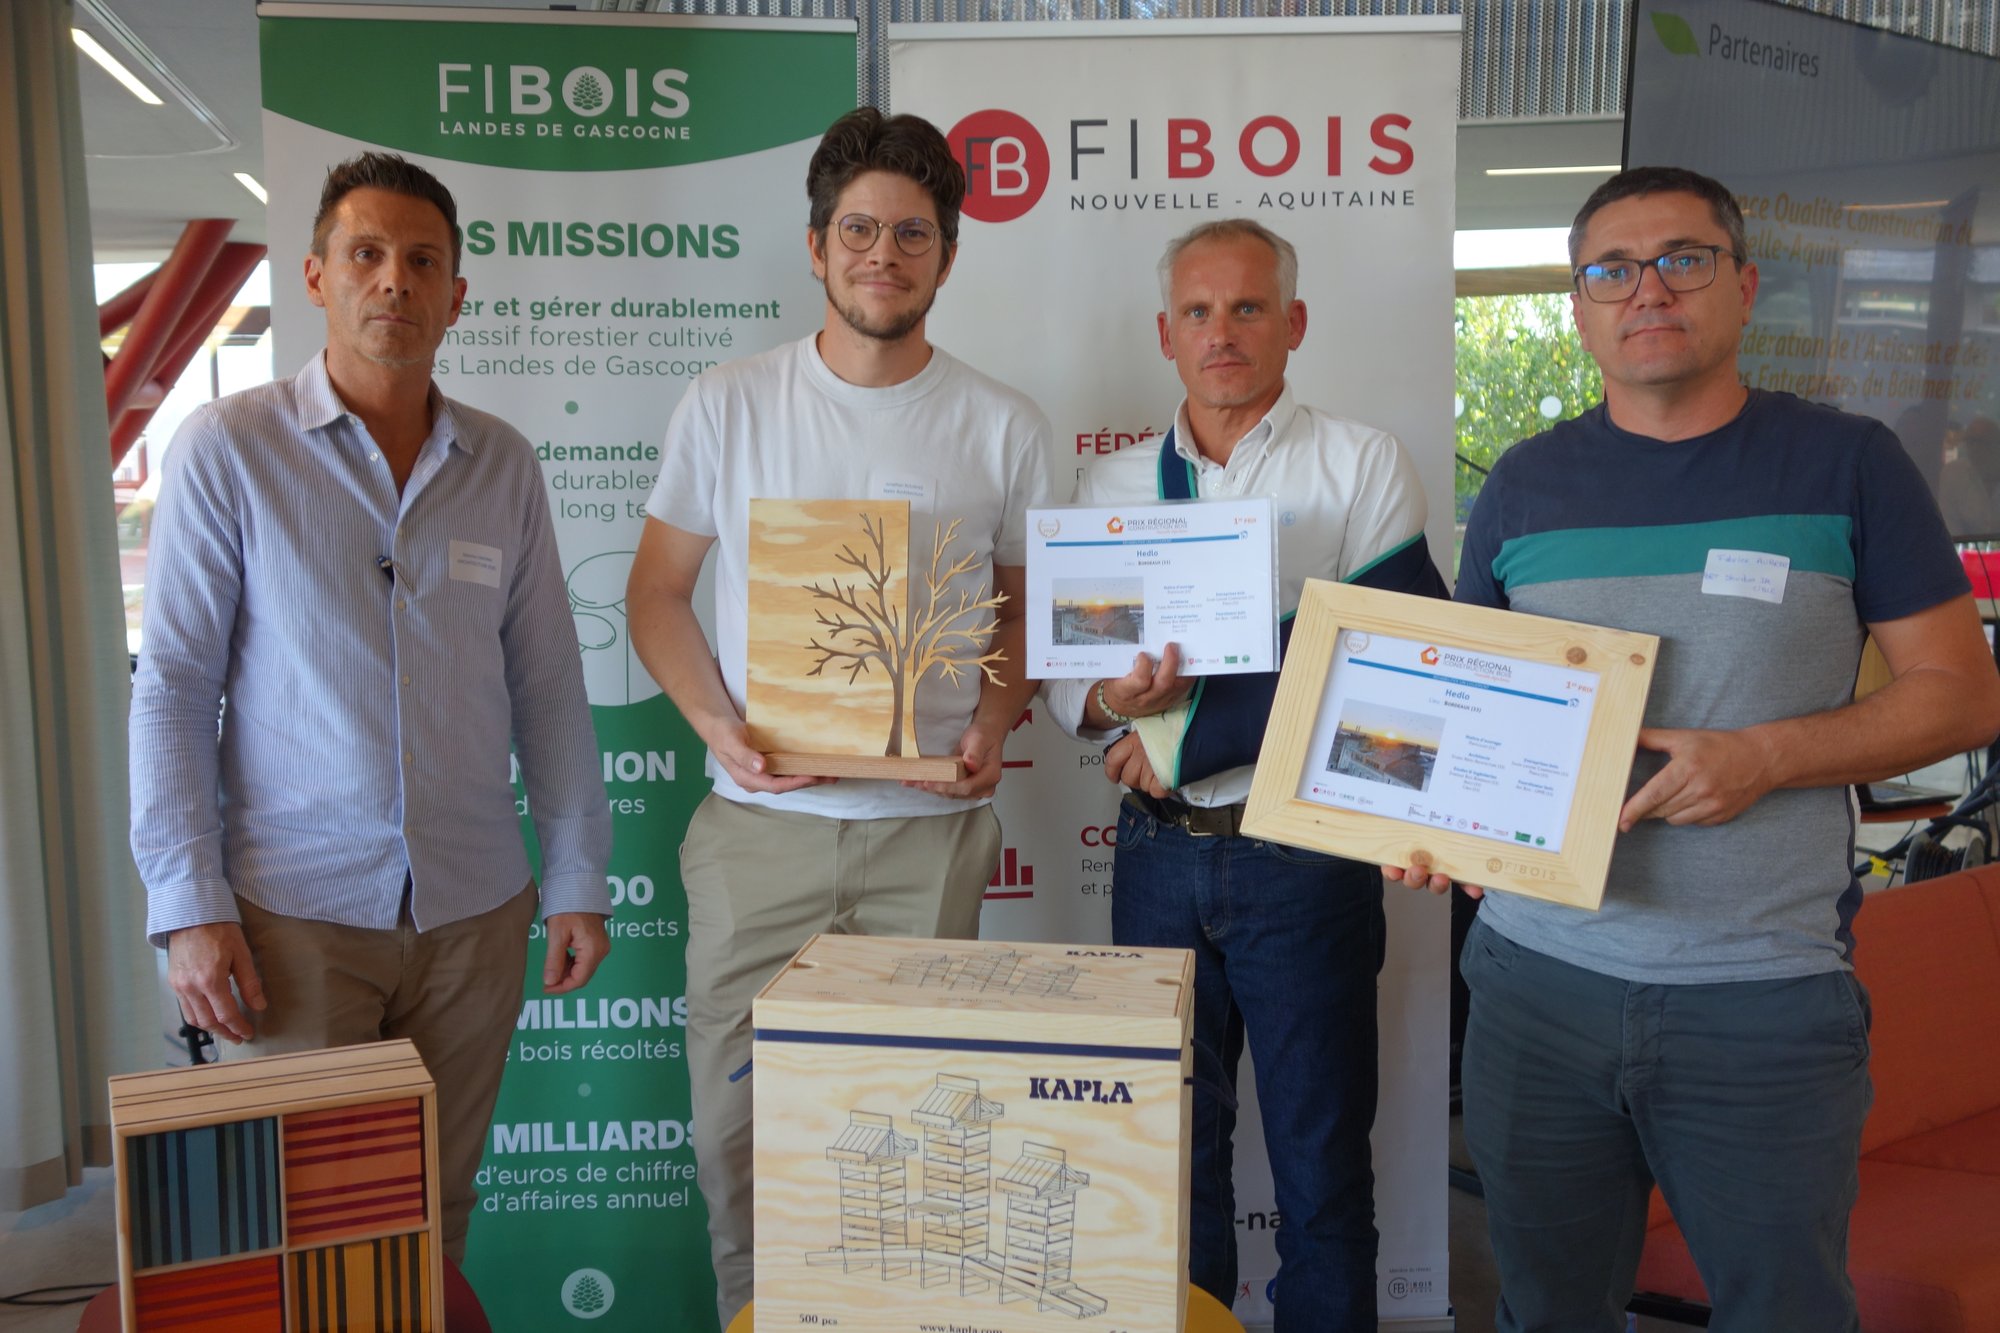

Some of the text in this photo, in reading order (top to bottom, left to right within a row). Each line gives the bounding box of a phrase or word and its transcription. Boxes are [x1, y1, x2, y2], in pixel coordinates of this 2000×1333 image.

[1708, 23, 1819, 78] Partenaires
[438, 62, 691, 119] FIBOIS
[440, 121, 691, 140] LANDES DE GASCOGNE
[1069, 113, 1415, 180] FIBOIS
[1070, 192, 1220, 211] NOUVELLE
[1258, 190, 1415, 211] AQUITAINE
[1774, 192, 1843, 230] Qualité
[1848, 206, 1953, 244] Construction
[507, 220, 741, 259] MISSIONS
[493, 297, 520, 317] et
[529, 295, 602, 321] gérer
[610, 297, 781, 319] durablement
[530, 325, 639, 347] forestier
[648, 326, 733, 348] cultivé
[460, 354, 555, 376] Landes
[563, 355, 597, 377] de
[1758, 364, 1858, 401] Entreprises
[535, 440, 659, 462] demande
[561, 498, 616, 523] long
[1443, 652, 1513, 673] PRIX RÉGIONAL
[1444, 688, 1471, 701] Hedlo
[1081, 858, 1114, 873] Ren
[1503, 861, 1558, 882] FIBOIS
[1081, 882, 1098, 896] et
[1066, 950, 1145, 959] KAPLA
[520, 1040, 573, 1062] bois
[581, 1038, 682, 1061] récoltés
[1029, 1076, 1134, 1105] KAPLA
[475, 1160, 697, 1187] d'euros de chiffre
[483, 1185, 690, 1213] d'affaires annuel
[799, 1313, 838, 1327] 500 pcs
